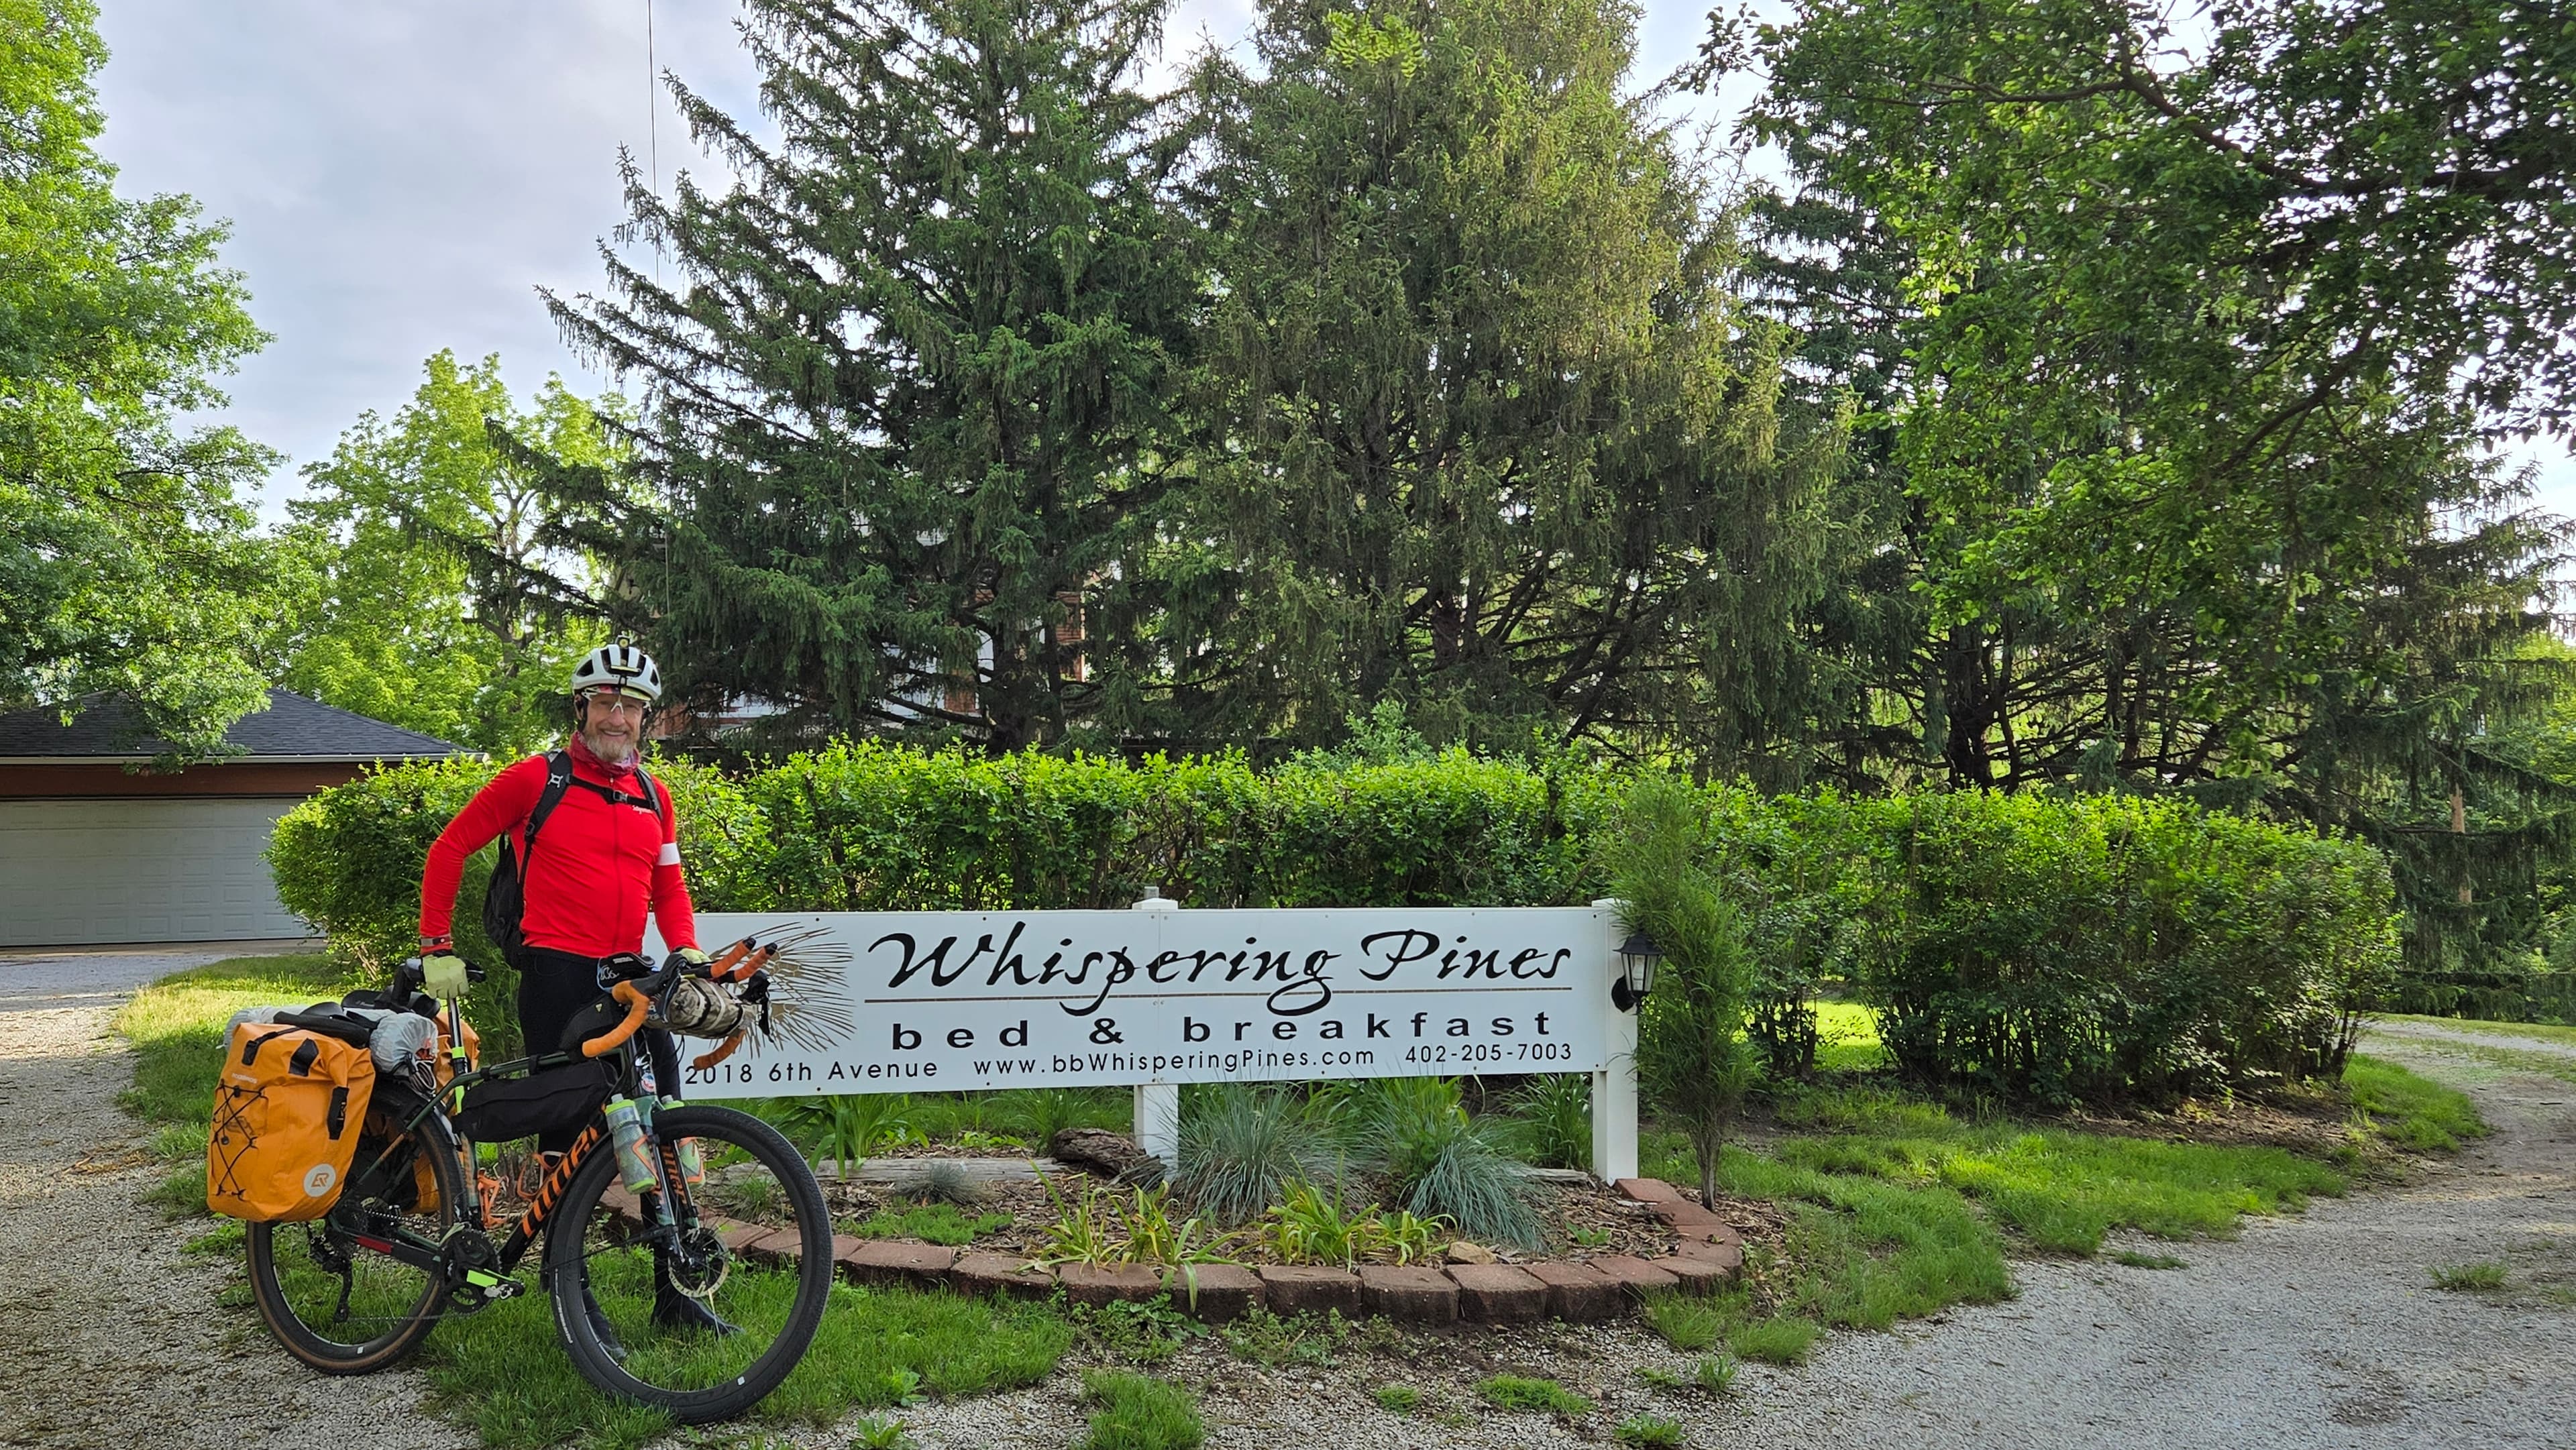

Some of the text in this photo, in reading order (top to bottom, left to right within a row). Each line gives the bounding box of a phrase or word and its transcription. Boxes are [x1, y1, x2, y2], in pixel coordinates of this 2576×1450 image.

[867, 921, 1572, 1017] Whispering Pines
[892, 1011, 1550, 1050] bed & breakfast
[684, 1043, 1572, 1084] 2018 6th Avenue www.bbWhisperingPines.com 402-205-7003
